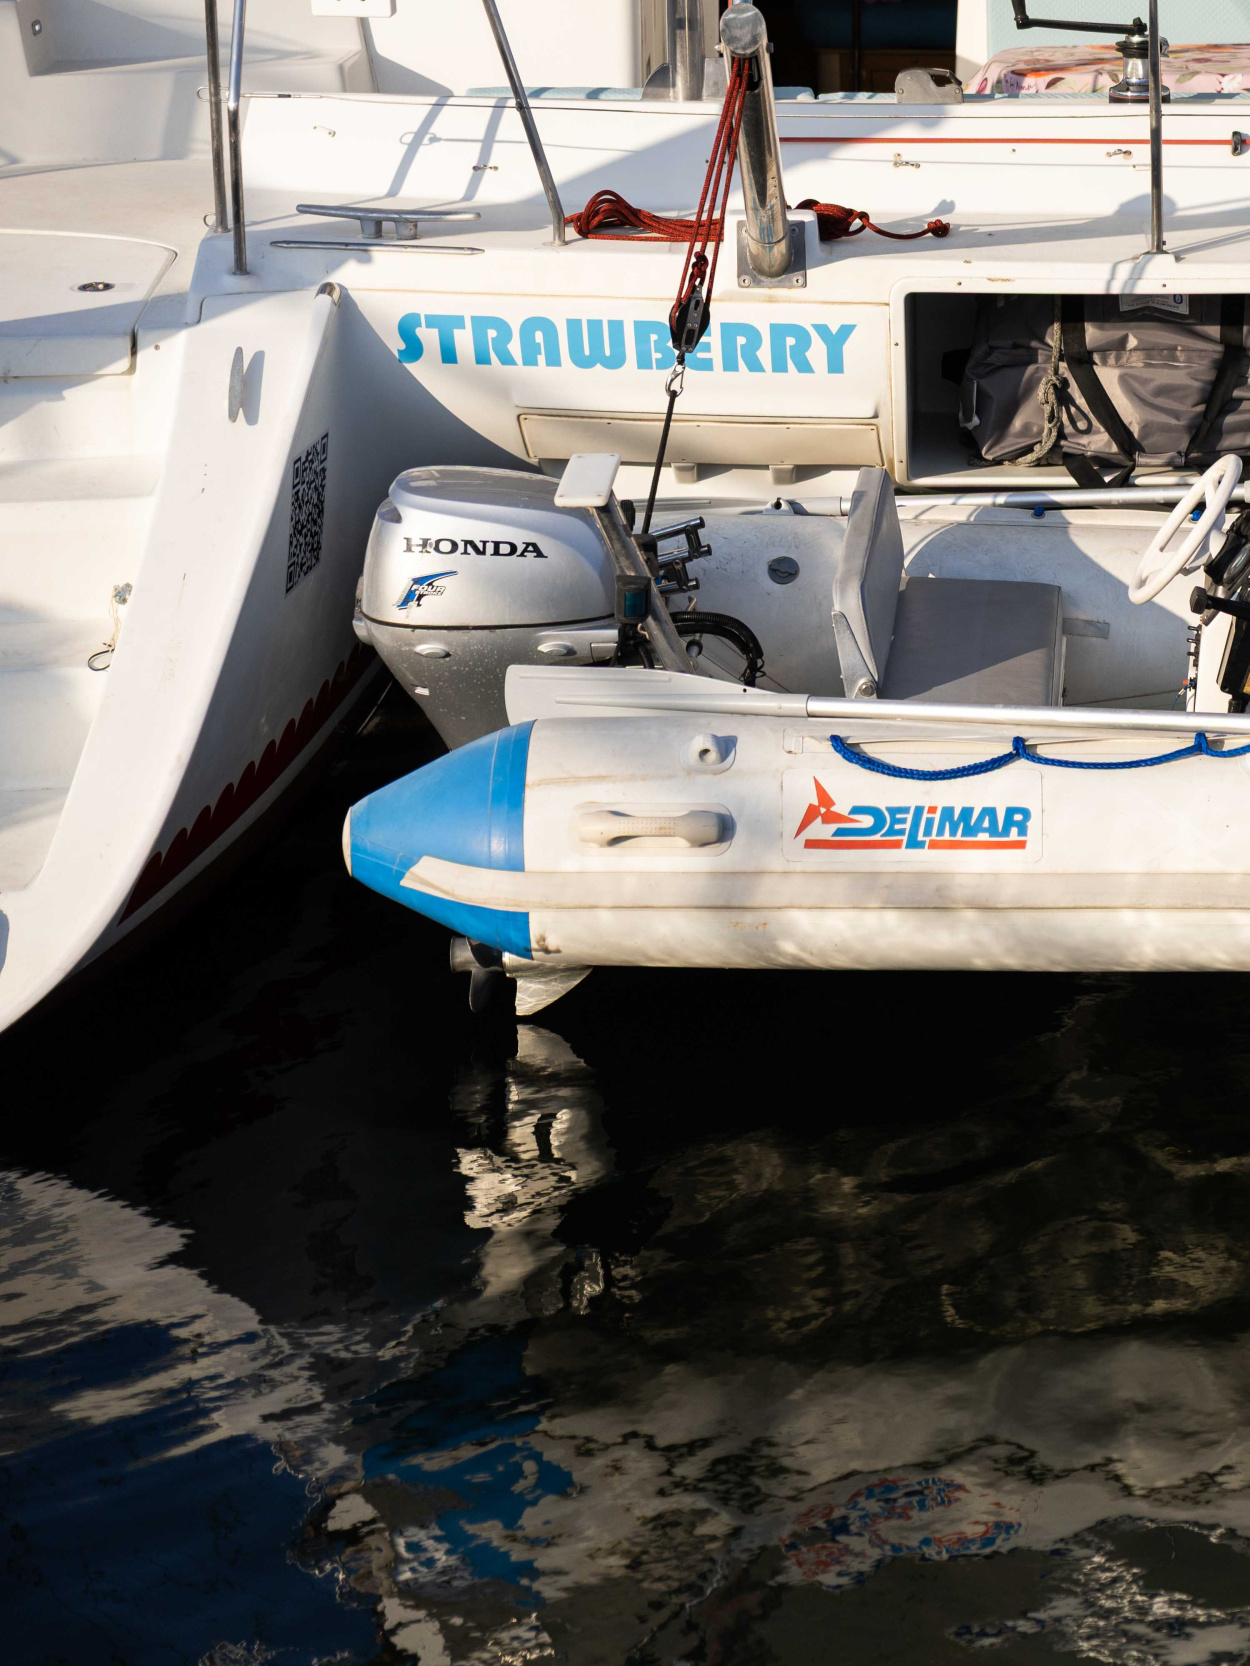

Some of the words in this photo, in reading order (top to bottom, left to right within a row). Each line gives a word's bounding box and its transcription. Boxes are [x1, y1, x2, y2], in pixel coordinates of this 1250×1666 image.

[397, 312, 858, 375] STRAWBERRY
[403, 536, 549, 559] HONDA
[411, 584, 446, 593] FOUR
